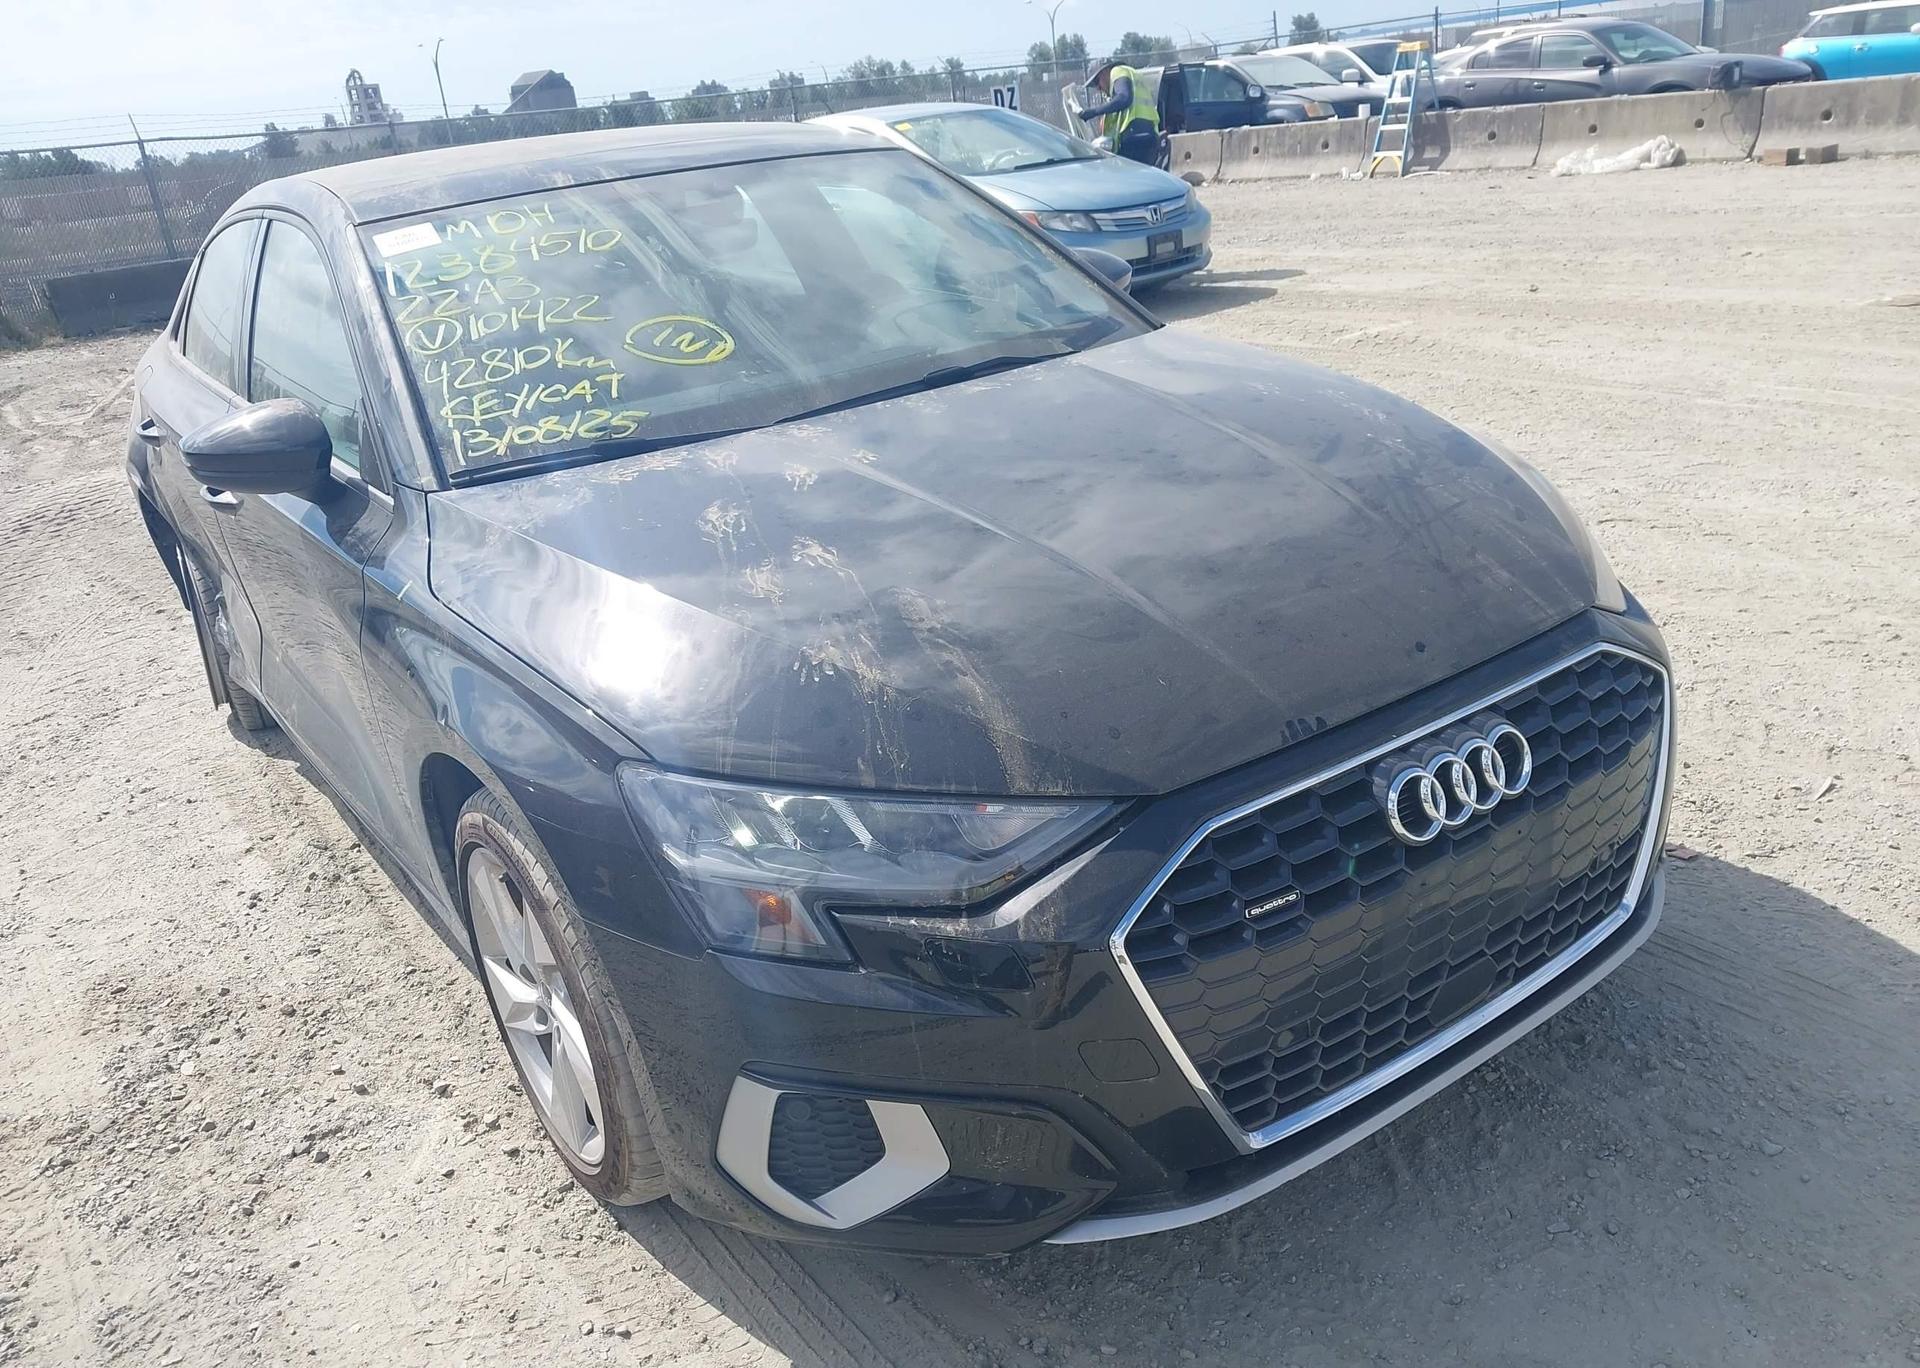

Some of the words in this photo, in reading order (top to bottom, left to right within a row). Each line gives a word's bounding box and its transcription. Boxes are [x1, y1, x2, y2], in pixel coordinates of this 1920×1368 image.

[384, 228, 622, 297] 12384510
[469, 294, 616, 341] 101422
[1250, 894, 1297, 915] quattro
